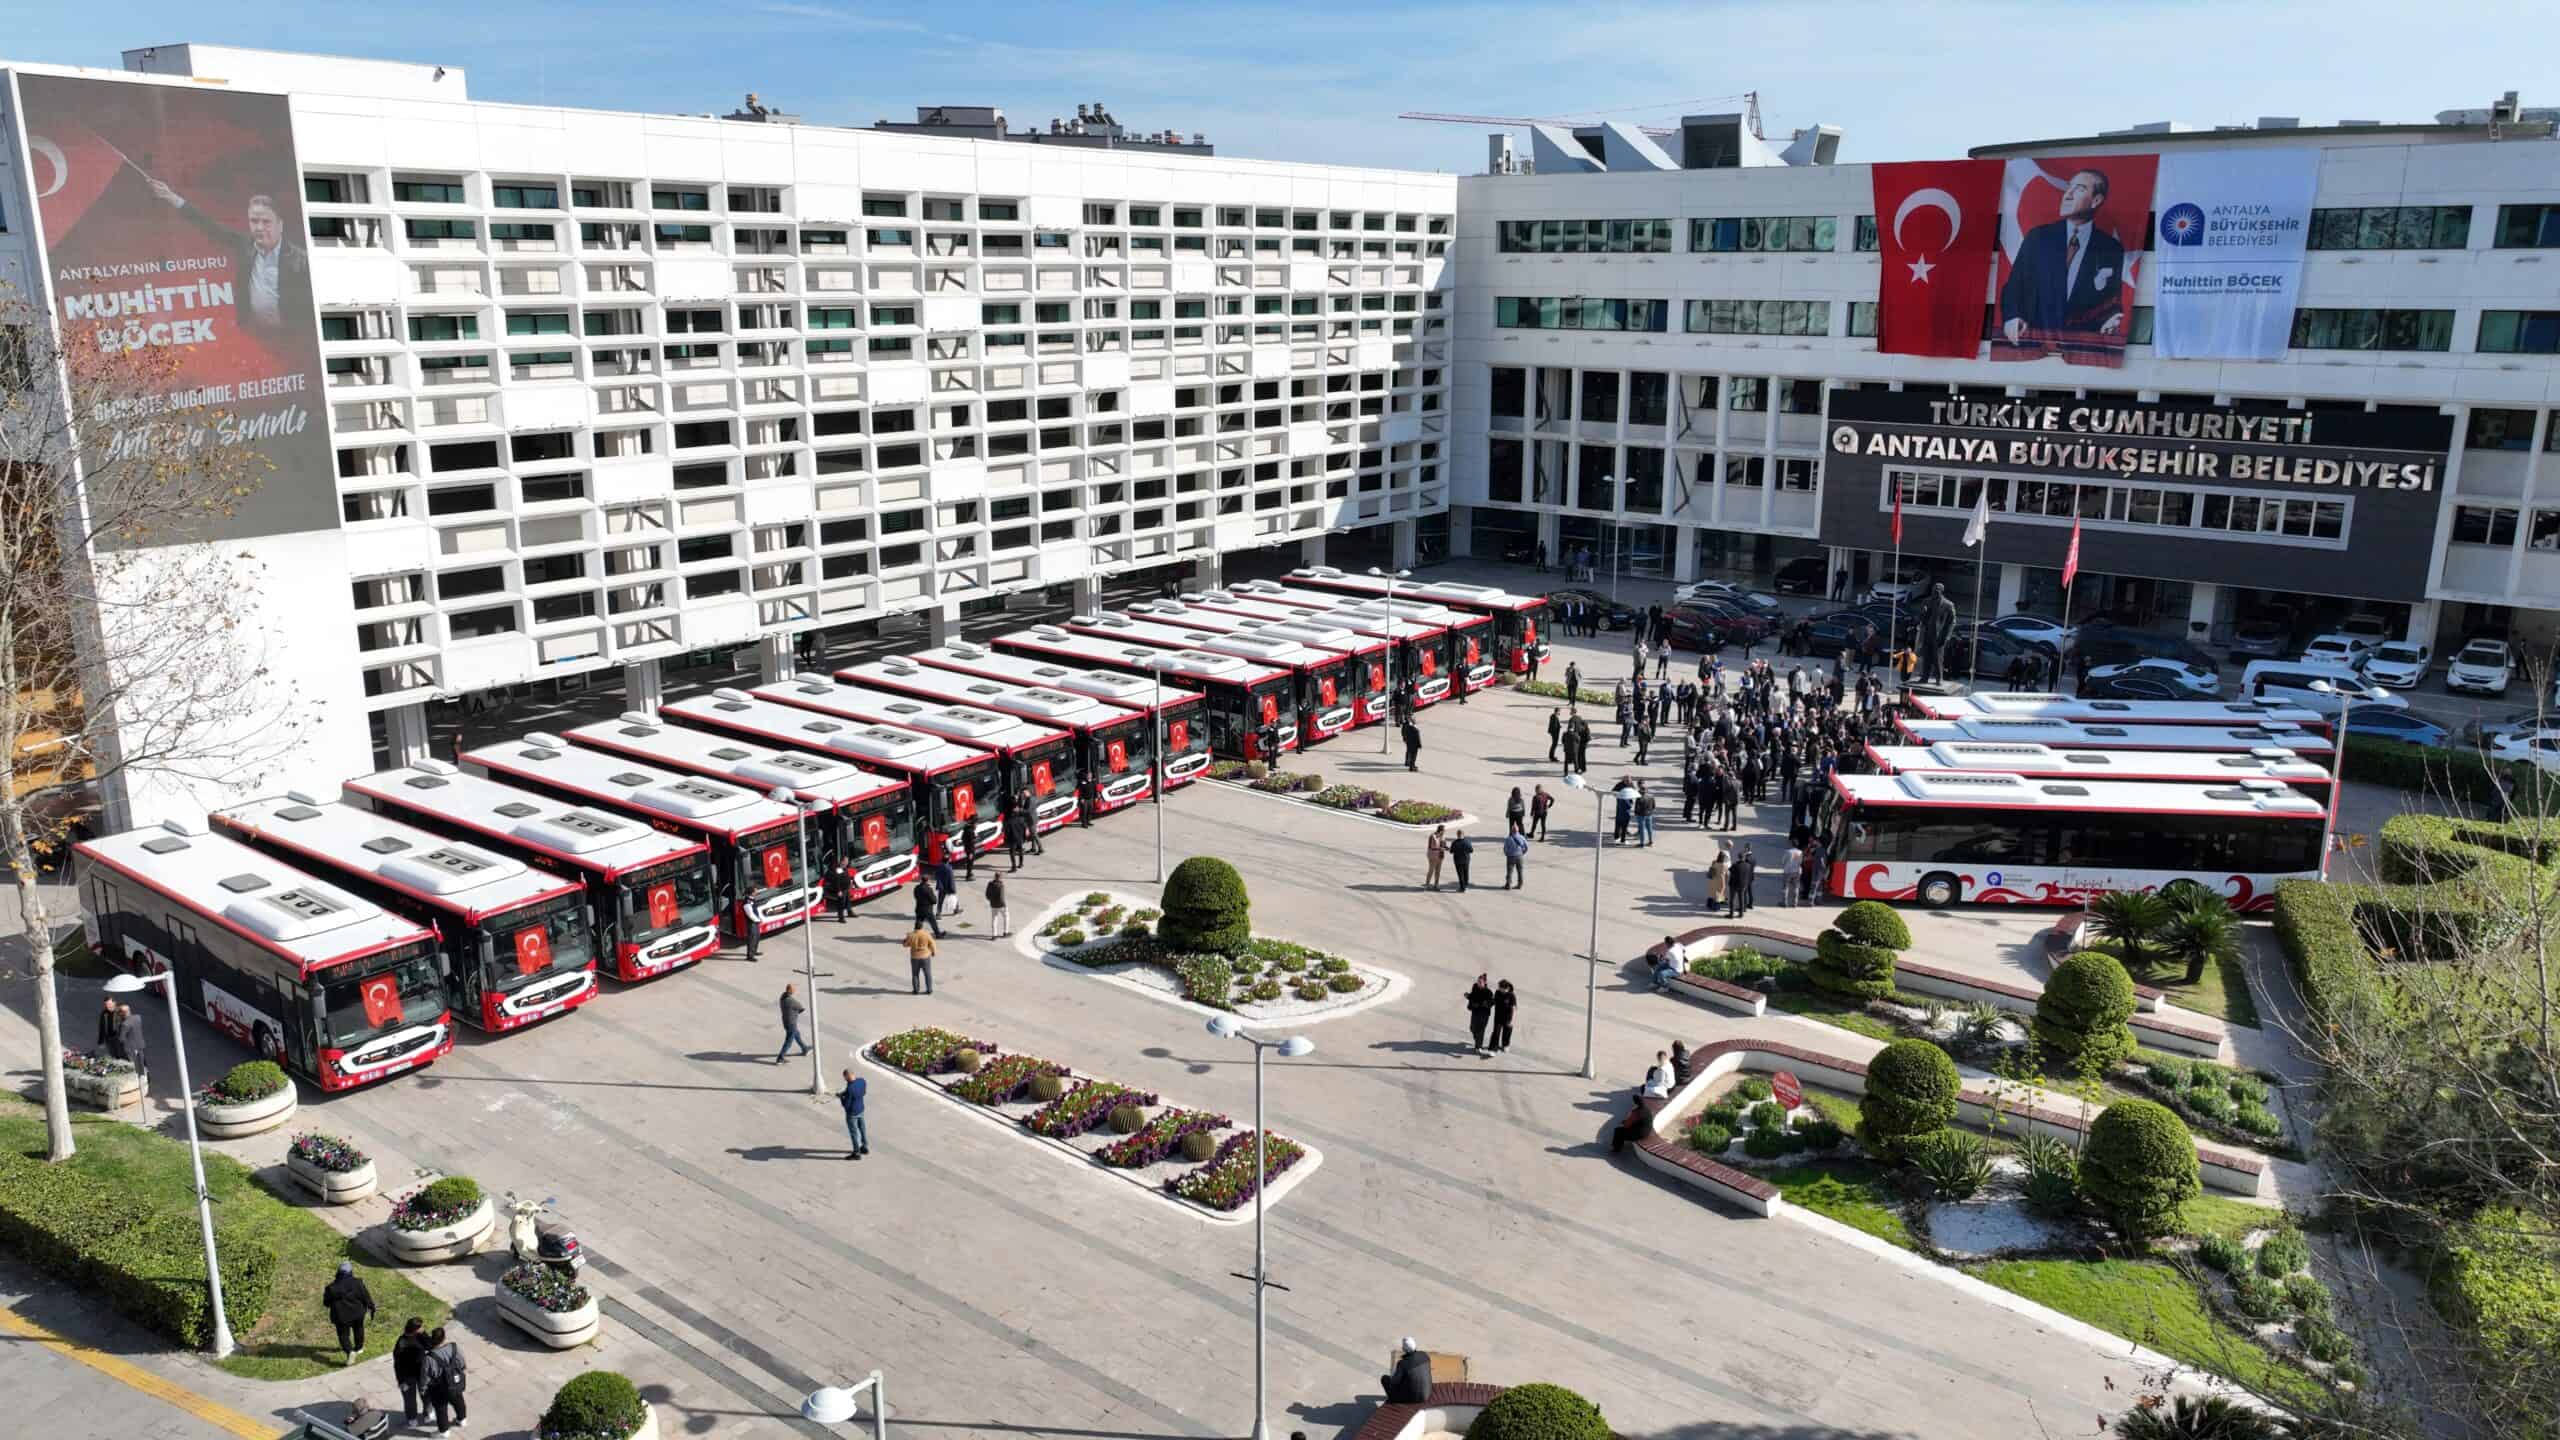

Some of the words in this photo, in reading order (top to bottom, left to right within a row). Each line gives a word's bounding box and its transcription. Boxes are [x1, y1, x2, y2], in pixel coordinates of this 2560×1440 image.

[2211, 204, 2272, 216] ANTALYA
[2210, 217, 2300, 234] BÜYÜKŞEHİR
[2208, 234, 2278, 247] BELEDİYESİ
[59, 261, 161, 280] ANTALYA'NIN
[166, 256, 227, 271] GURURU
[2162, 275, 2223, 288] Muhittin
[2227, 272, 2283, 287] BÖCEK
[64, 278, 234, 320] MUHİTTİN
[239, 373, 305, 399] GELECEKTE
[217, 404, 307, 446] Seninle
[1930, 395, 2061, 430] TÜRKİYE
[2069, 407, 2312, 443] CUMHURİYETİ
[1866, 433, 1999, 463] ANTALYA
[2009, 436, 2219, 478] BÜYÜKŞEHİR
[2230, 454, 2436, 491] BELEDİYESİ
